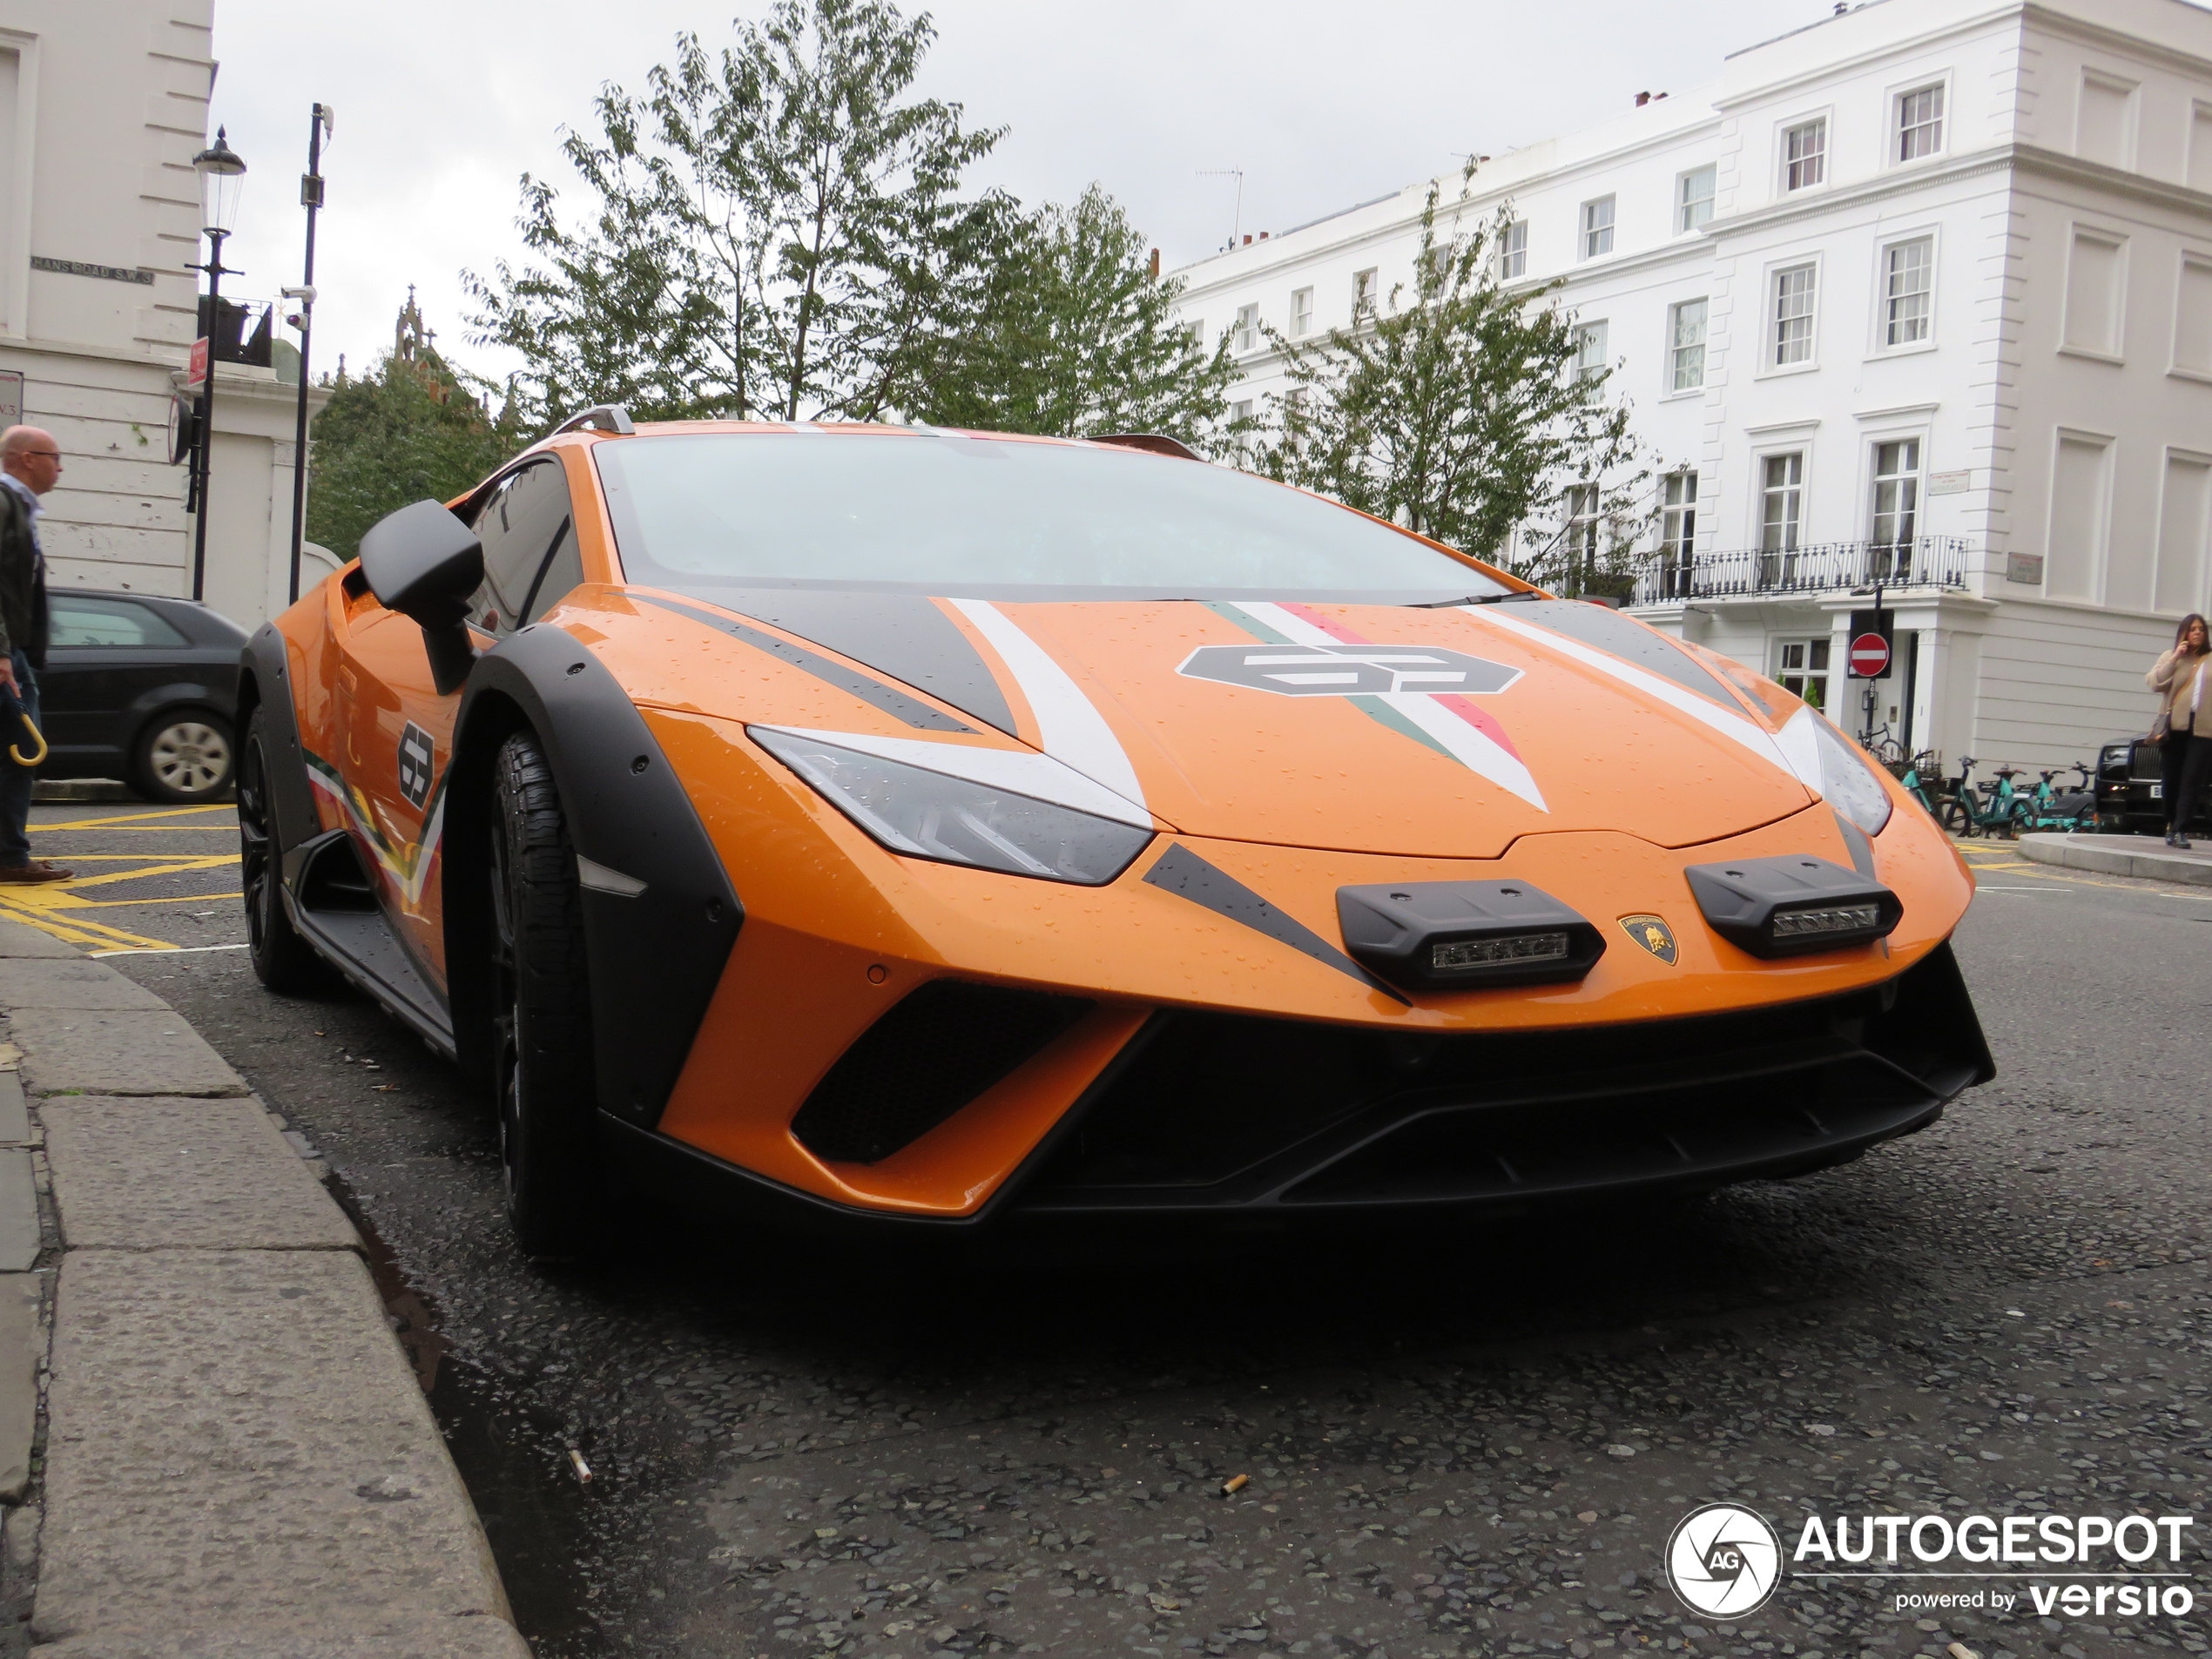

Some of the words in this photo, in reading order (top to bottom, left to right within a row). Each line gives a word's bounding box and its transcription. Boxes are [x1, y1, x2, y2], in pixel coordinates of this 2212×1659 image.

[34, 257, 69, 272] HANS
[71, 262, 110, 278] ROAD
[1622, 917, 1663, 927] LAMBORGHINI
